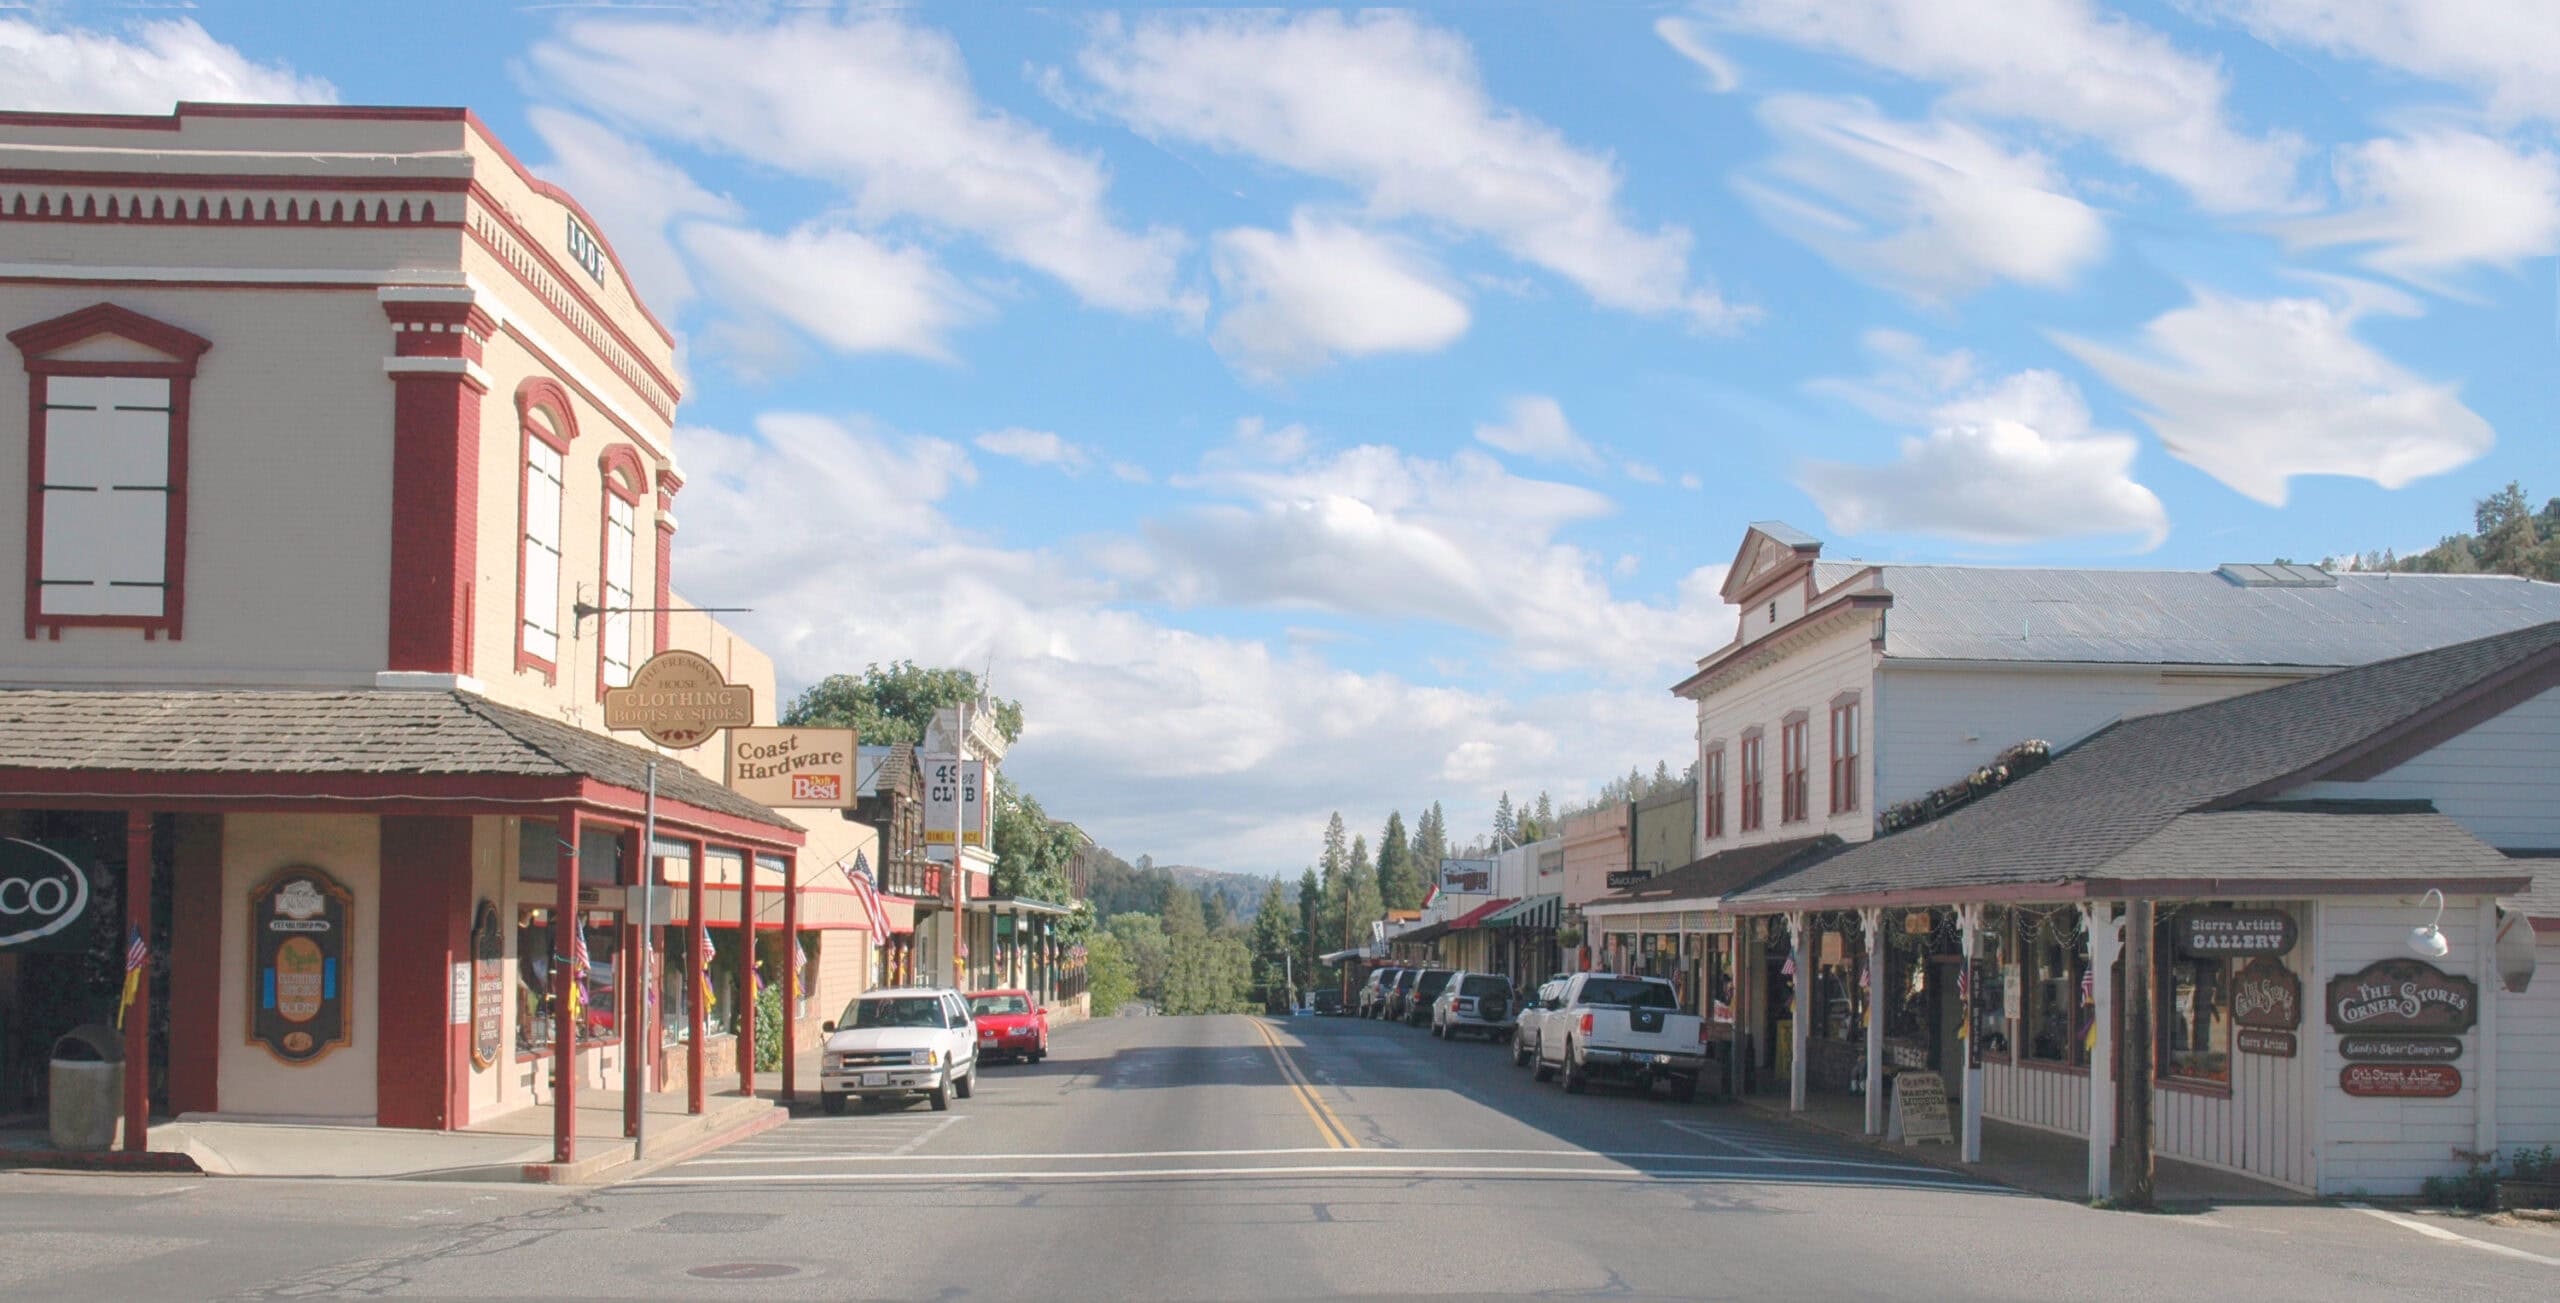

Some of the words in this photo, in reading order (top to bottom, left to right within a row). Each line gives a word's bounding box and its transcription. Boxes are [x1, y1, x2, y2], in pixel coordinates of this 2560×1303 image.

[640, 666, 658, 688] THE
[661, 656, 717, 686] FREMONT
[659, 680, 697, 689] HOUSE
[625, 691, 732, 707] CLOTHING
[615, 710, 668, 722] BOOTS
[673, 710, 684, 721] &
[691, 708, 744, 721] SHOES
[737, 733, 799, 760] Coast
[738, 751, 843, 780] Hardware
[793, 778, 838, 799] Best
[932, 786, 975, 802] CLB
[2192, 920, 2232, 931] Sierra
[2236, 920, 2284, 931] Artists
[2192, 935, 2282, 949] GALLERY
[2358, 983, 2392, 1001] THE
[2338, 998, 2400, 1023] CORNER
[2400, 982, 2469, 1018] STORES
